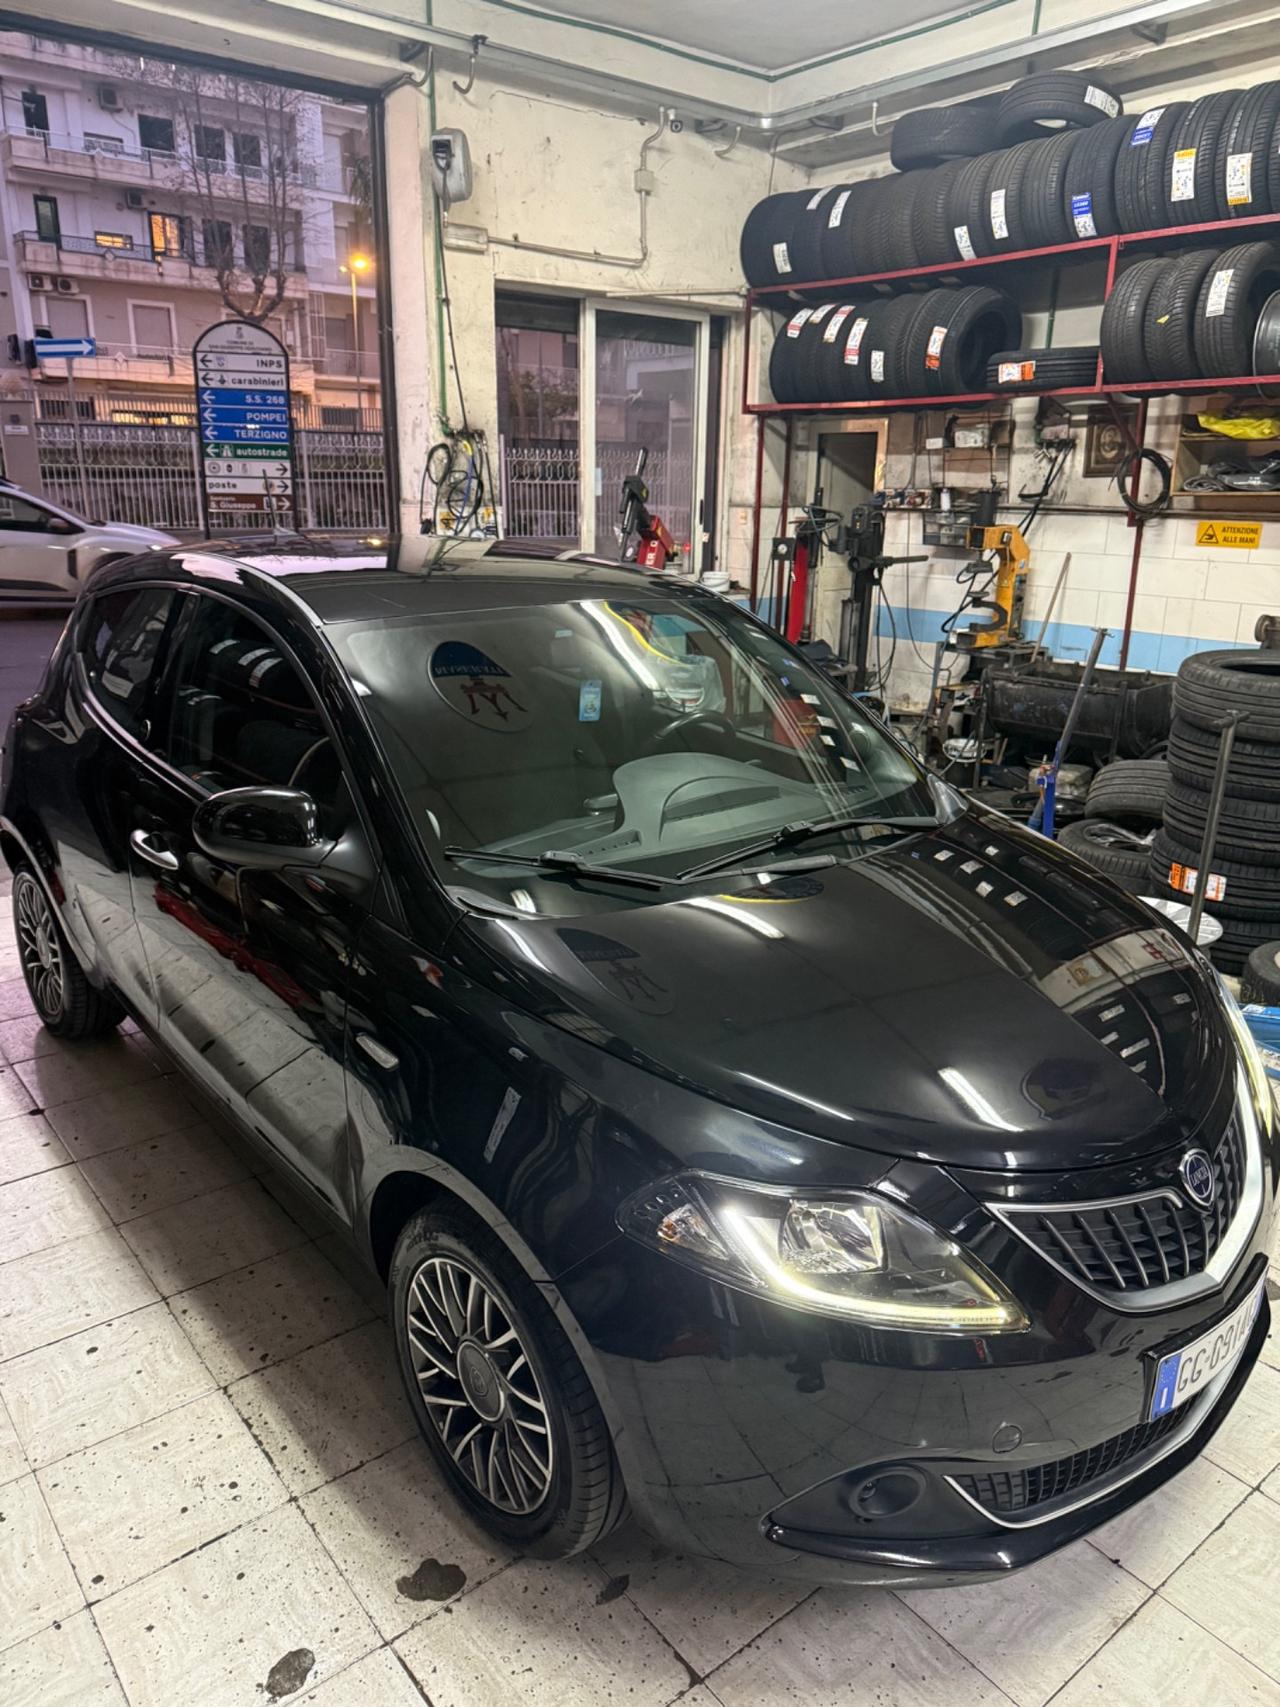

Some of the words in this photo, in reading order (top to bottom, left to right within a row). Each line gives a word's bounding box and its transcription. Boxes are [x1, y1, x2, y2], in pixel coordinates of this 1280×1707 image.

[256, 359, 283, 368] INPS
[231, 376, 284, 386] carabinieri
[245, 394, 262, 404] S.S.
[265, 395, 285, 404] 268
[246, 412, 286, 422] POMPEI
[233, 430, 287, 439] TERZIGNO
[236, 448, 288, 456] autostrade
[208, 481, 237, 489] poste
[1221, 526, 1259, 535] ATTENZIONE
